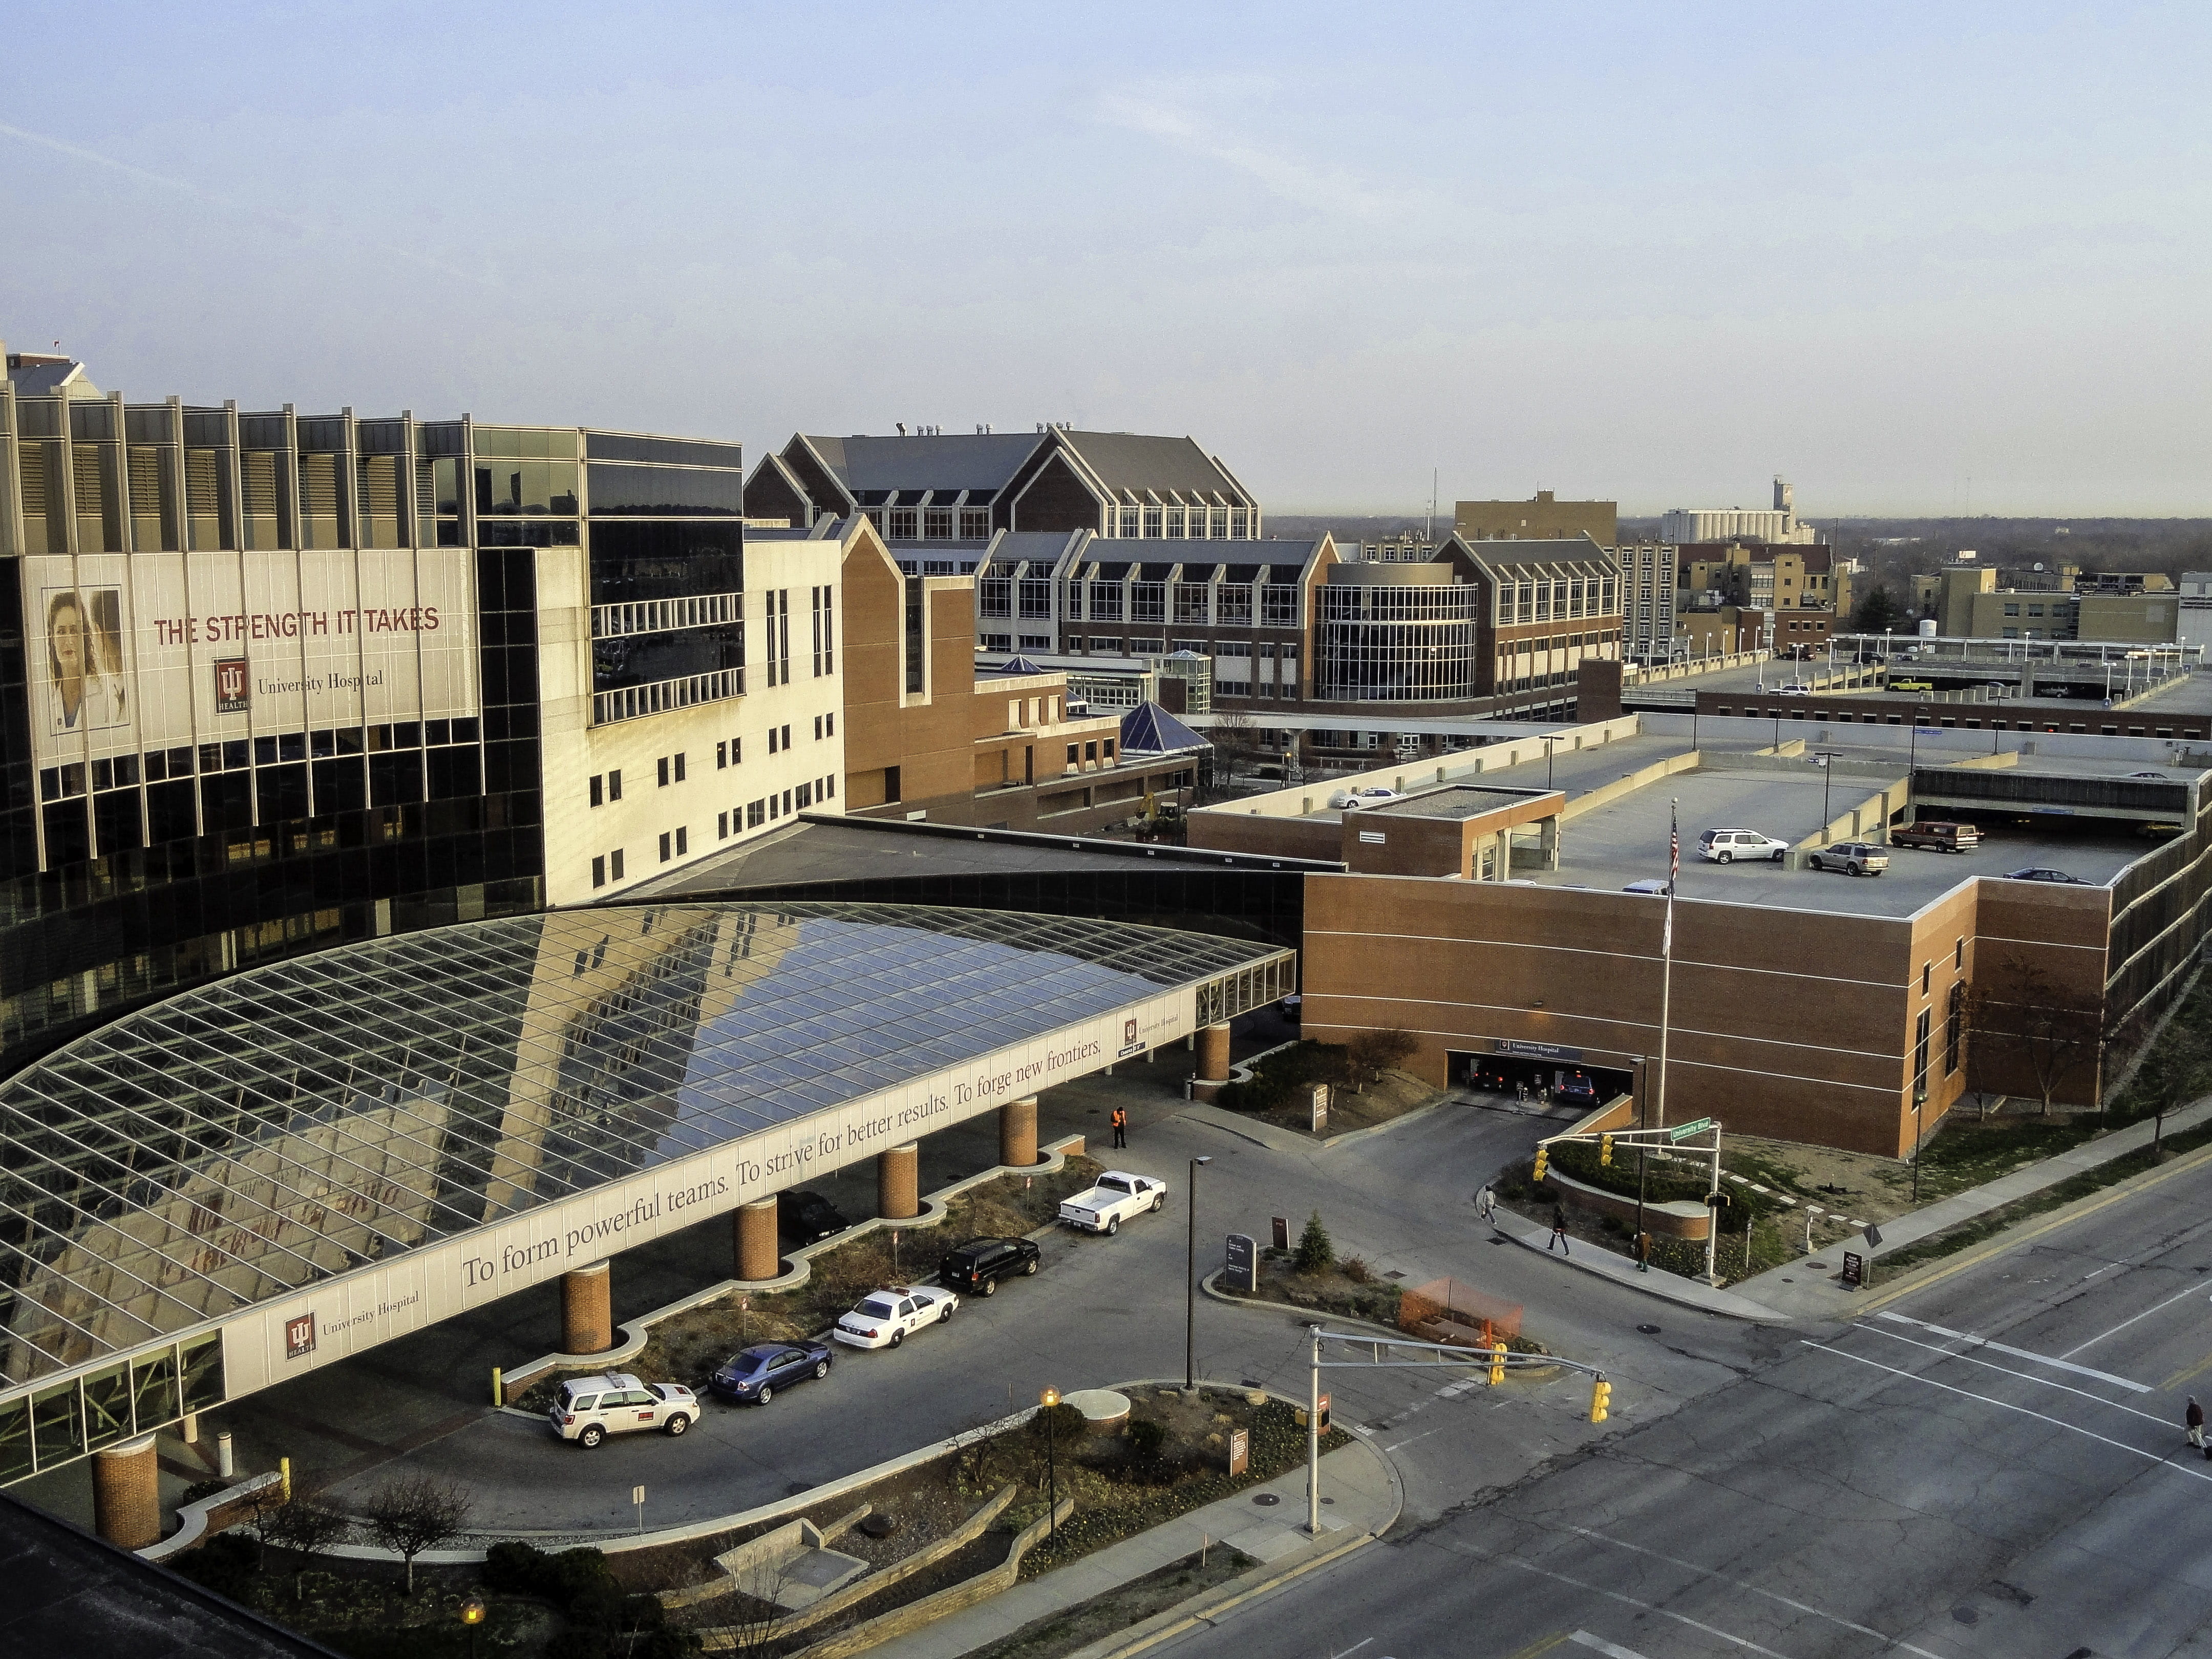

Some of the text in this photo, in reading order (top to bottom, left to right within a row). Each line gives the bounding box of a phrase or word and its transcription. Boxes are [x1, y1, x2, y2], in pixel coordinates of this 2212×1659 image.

[154, 607, 439, 645] THE STRENGTH IT TAKES
[258, 670, 383, 694] University Hosptal
[219, 700, 247, 711] HEALTH
[1513, 1043, 1537, 1052] University
[1538, 1045, 1559, 1054] Hospital
[1673, 1121, 1708, 1137] University Blvd
[463, 1040, 1101, 1287] To form powerful teams. To strive for better results. To forge new frontiers.
[322, 1290, 419, 1335] University Hospital
